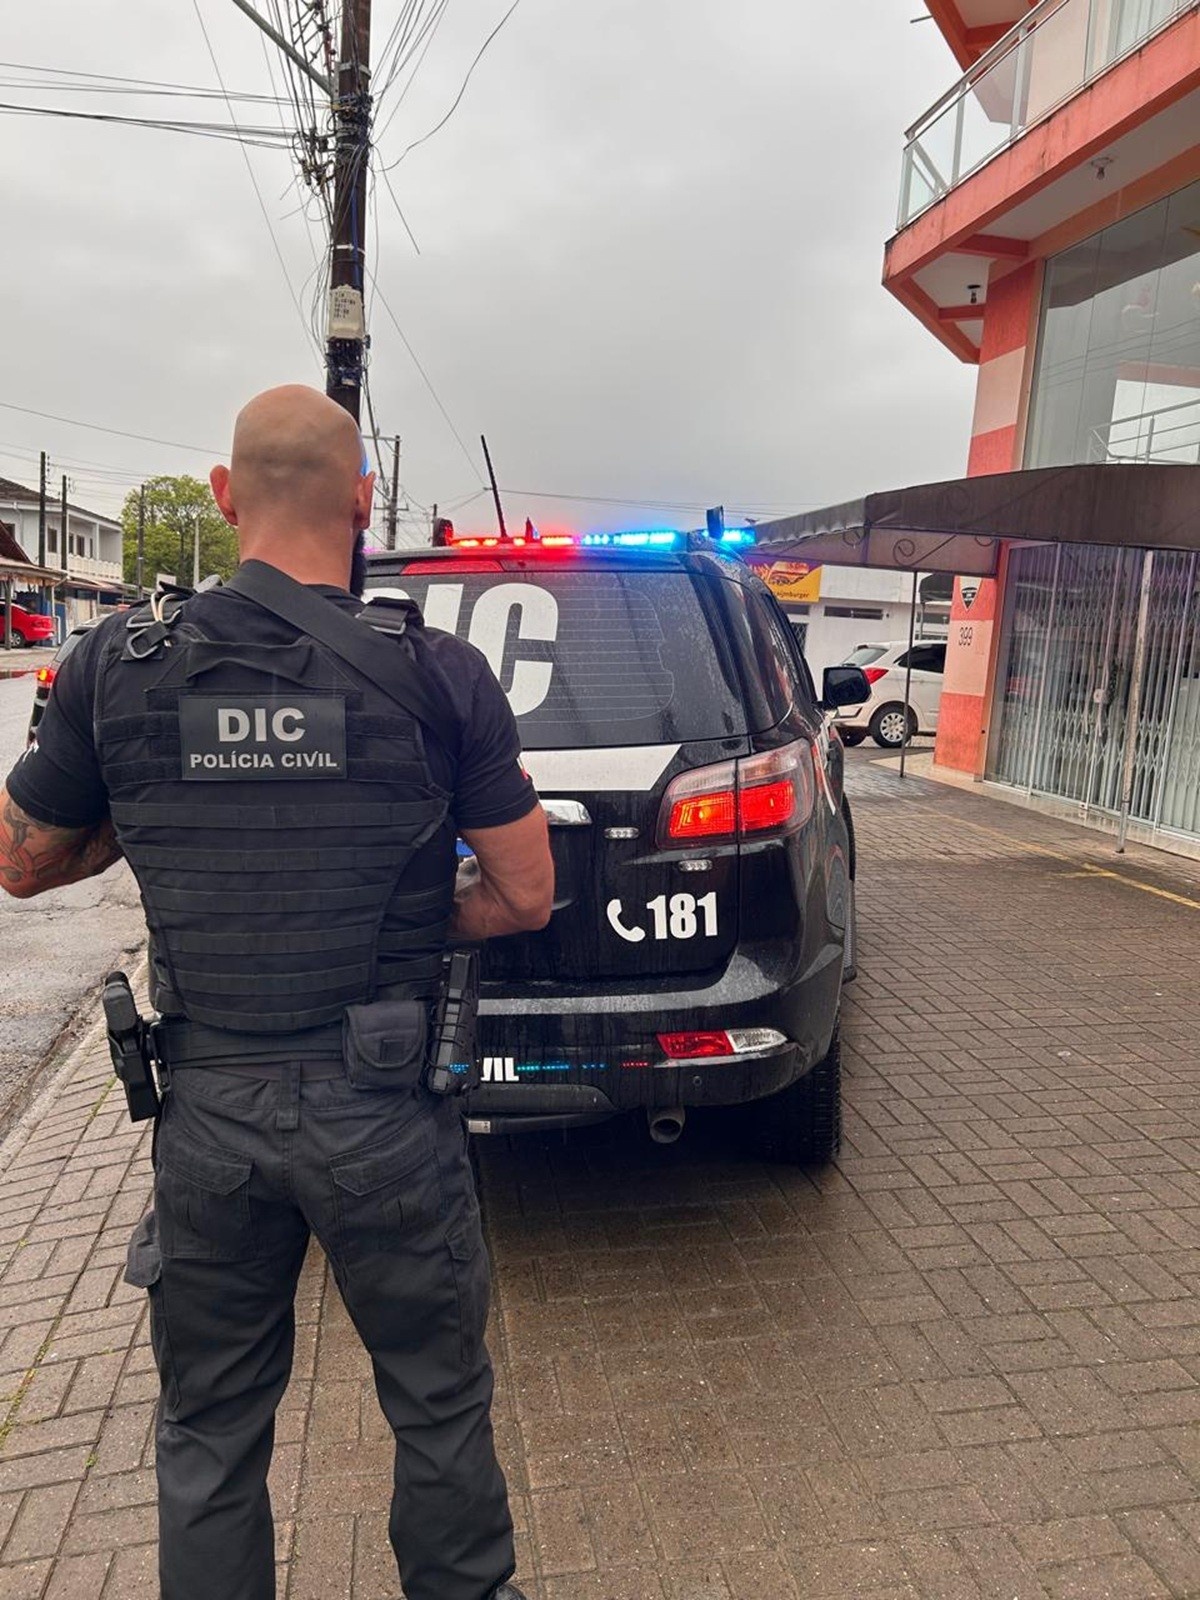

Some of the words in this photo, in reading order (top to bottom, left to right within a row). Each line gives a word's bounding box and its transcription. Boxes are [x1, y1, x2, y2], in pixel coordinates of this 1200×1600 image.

[217, 707, 306, 742] DIC
[190, 751, 275, 768] POLÍCIA
[281, 752, 337, 767] CIVIL
[646, 891, 718, 940] 181
